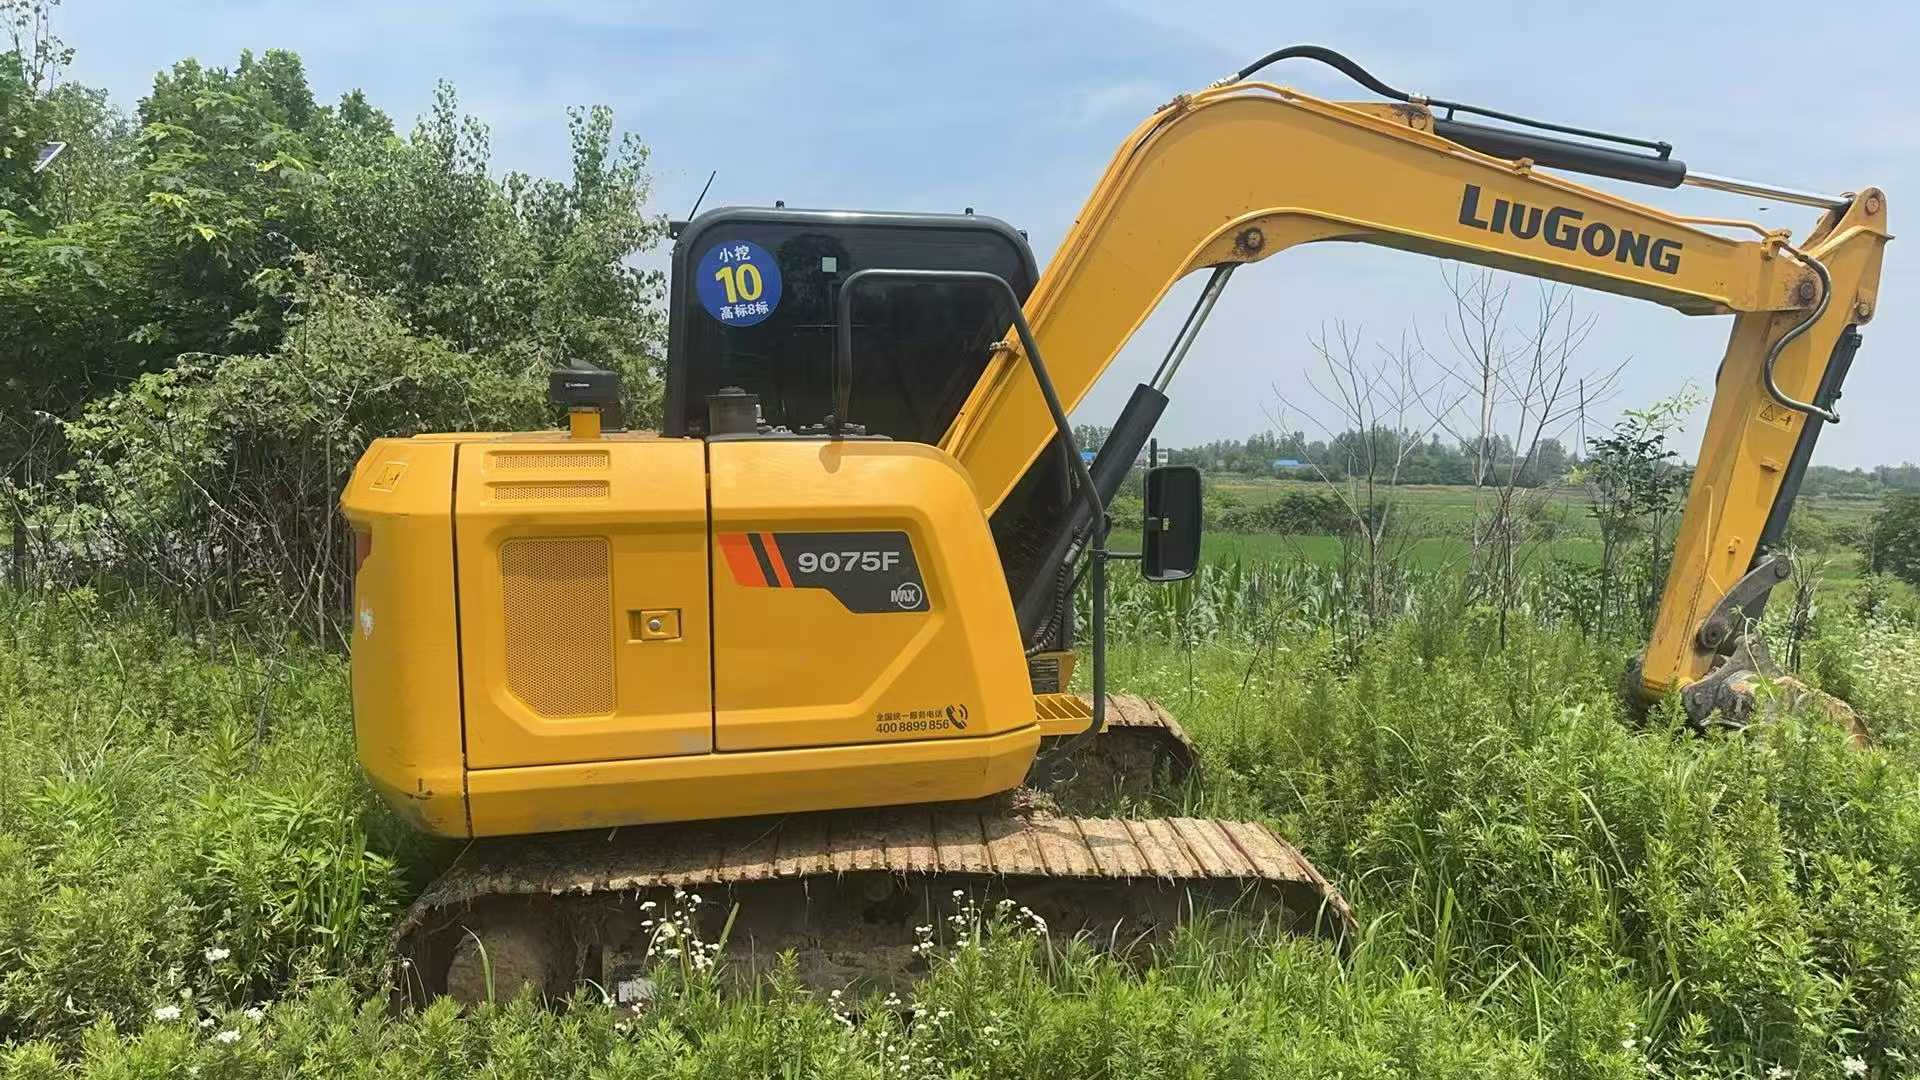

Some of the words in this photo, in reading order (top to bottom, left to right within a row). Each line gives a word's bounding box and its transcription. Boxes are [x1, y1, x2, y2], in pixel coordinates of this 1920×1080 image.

[719, 245, 751, 262] 小挖
[715, 263, 762, 303] 10
[719, 301, 769, 320] 高标8标
[798, 551, 900, 572] 9075F
[891, 589, 916, 603] MAX
[876, 722, 898, 733] 400
